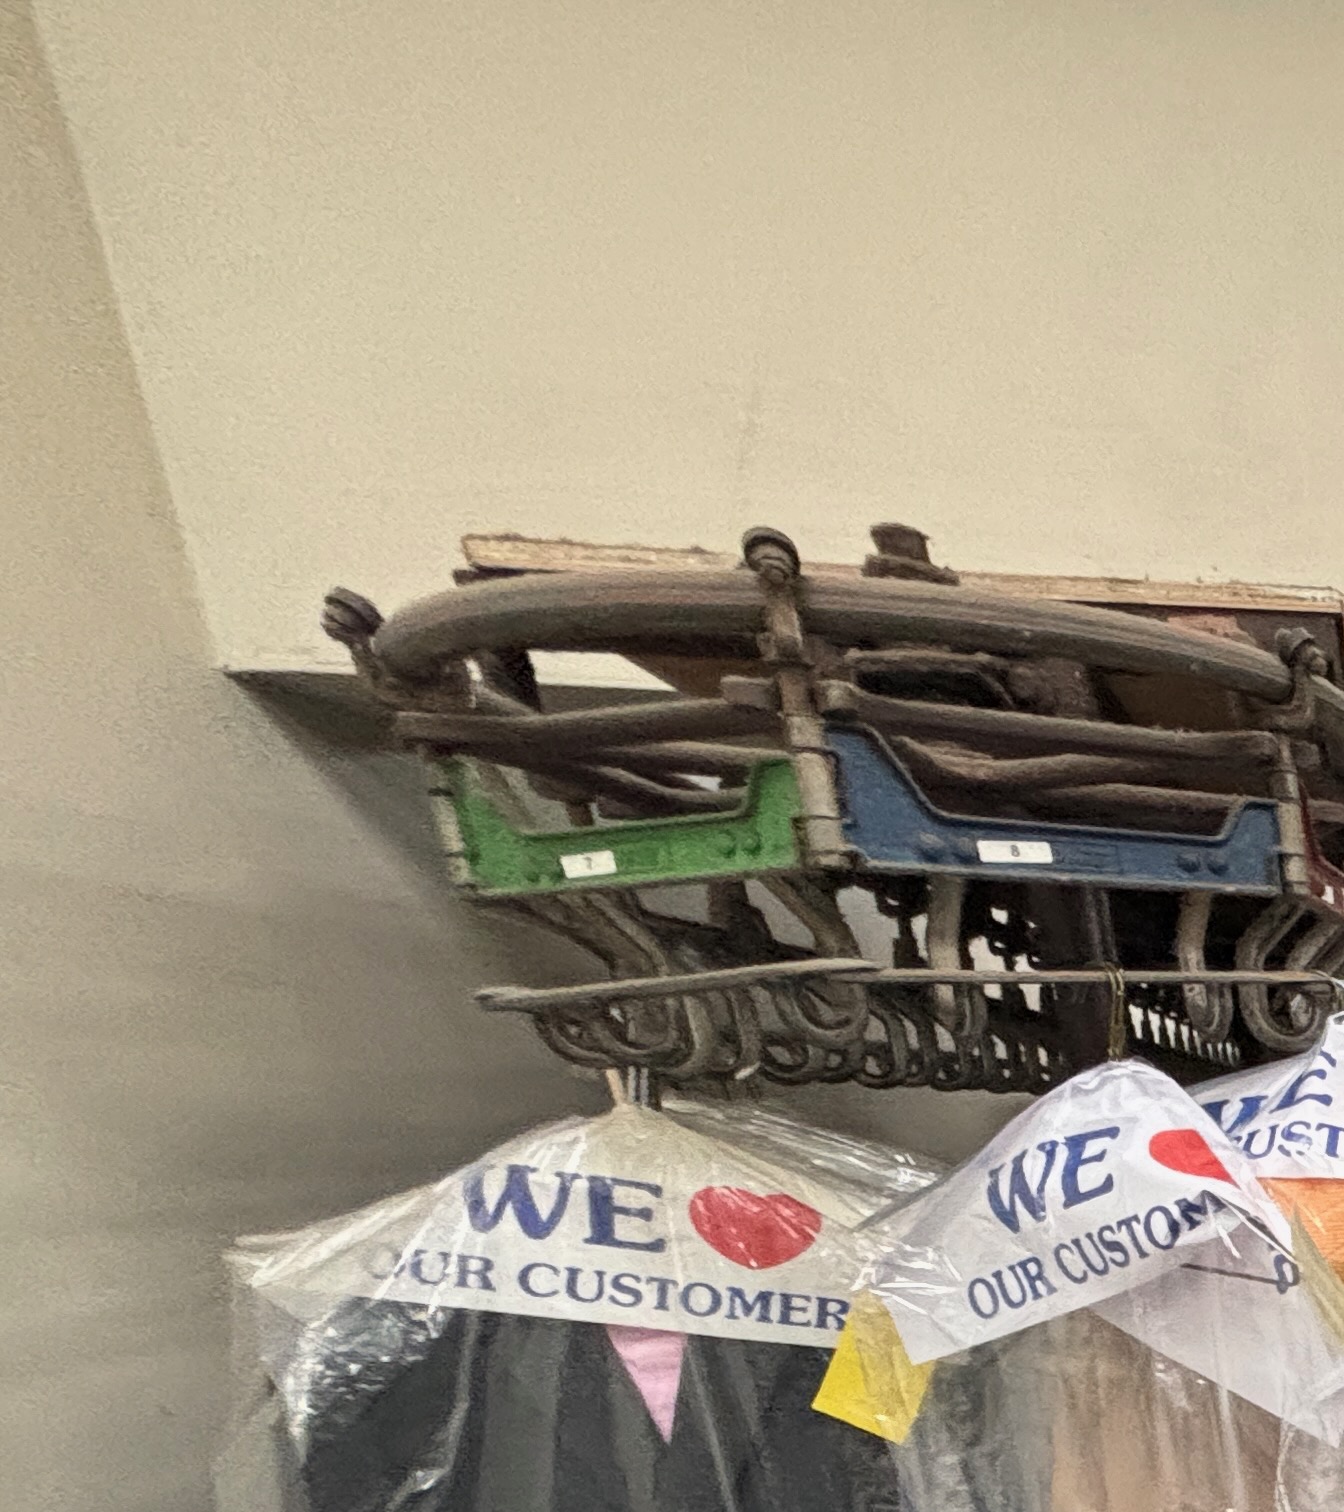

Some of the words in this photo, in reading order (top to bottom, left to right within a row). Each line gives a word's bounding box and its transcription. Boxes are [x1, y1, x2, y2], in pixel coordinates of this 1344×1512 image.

[1010, 844, 1021, 858] 8
[461, 1163, 666, 1253] WE
[986, 1126, 1121, 1235] WE
[364, 1248, 497, 1293] OUR
[517, 1261, 852, 1331] CUSTOMER
[967, 1256, 1058, 1320] OUR
